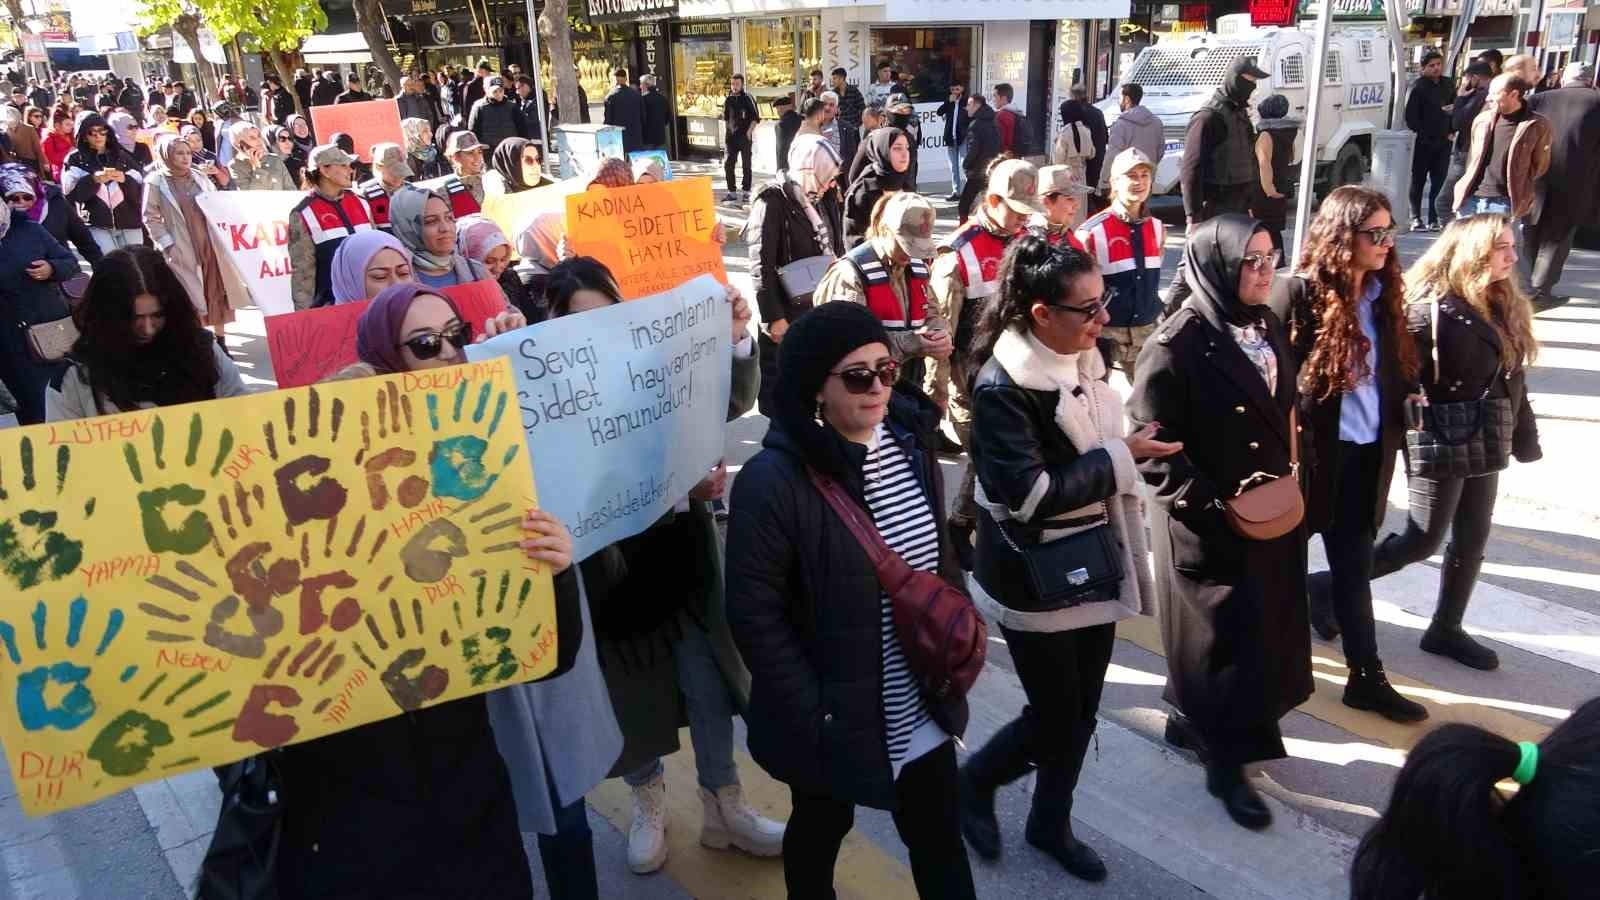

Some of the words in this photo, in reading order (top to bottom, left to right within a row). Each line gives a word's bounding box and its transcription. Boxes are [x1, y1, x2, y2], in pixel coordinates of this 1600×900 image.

[849, 30, 859, 70] VAN
[1349, 86, 1385, 105] ILGAZ
[577, 194, 646, 222] KADINA
[623, 208, 708, 239] SIDETTE
[629, 240, 688, 266] HAYIR
[519, 337, 599, 381] Sevgi
[630, 296, 717, 350] insanların
[626, 335, 718, 399] hayvanların
[50, 417, 149, 446] LÜTFEN
[223, 443, 265, 480] DUR
[391, 498, 453, 538] HAYIR
[80, 555, 160, 588] YAPMA
[422, 574, 466, 605] DUR
[155, 648, 232, 673] NEDEN
[20, 751, 85, 780] DUR
